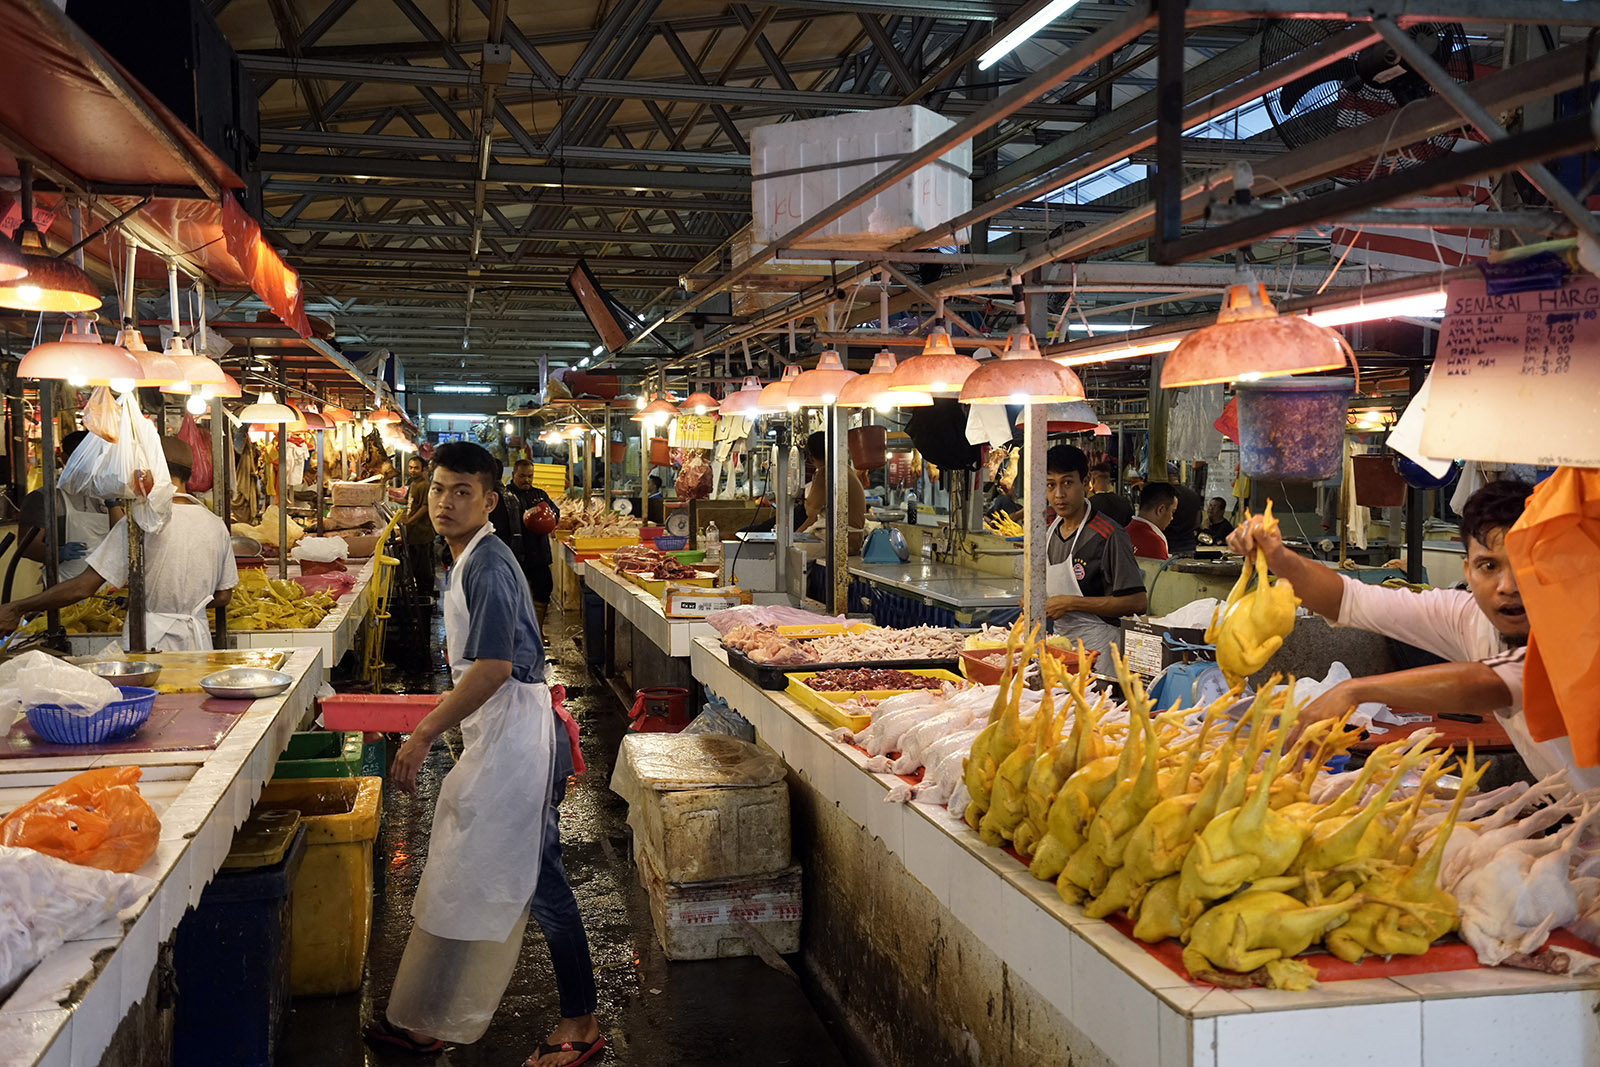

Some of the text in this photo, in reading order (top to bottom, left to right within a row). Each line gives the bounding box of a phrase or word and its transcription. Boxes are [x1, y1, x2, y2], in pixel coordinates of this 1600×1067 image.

[1454, 288, 1600, 314] SENARAI HARG
[1449, 317, 1474, 328] AYAM
[1477, 315, 1503, 326] BULAT
[1449, 327, 1475, 338] AYAM
[1477, 326, 1495, 336] TUA
[1446, 337, 1471, 347] AYAM
[1476, 335, 1519, 346] KAMPUNG
